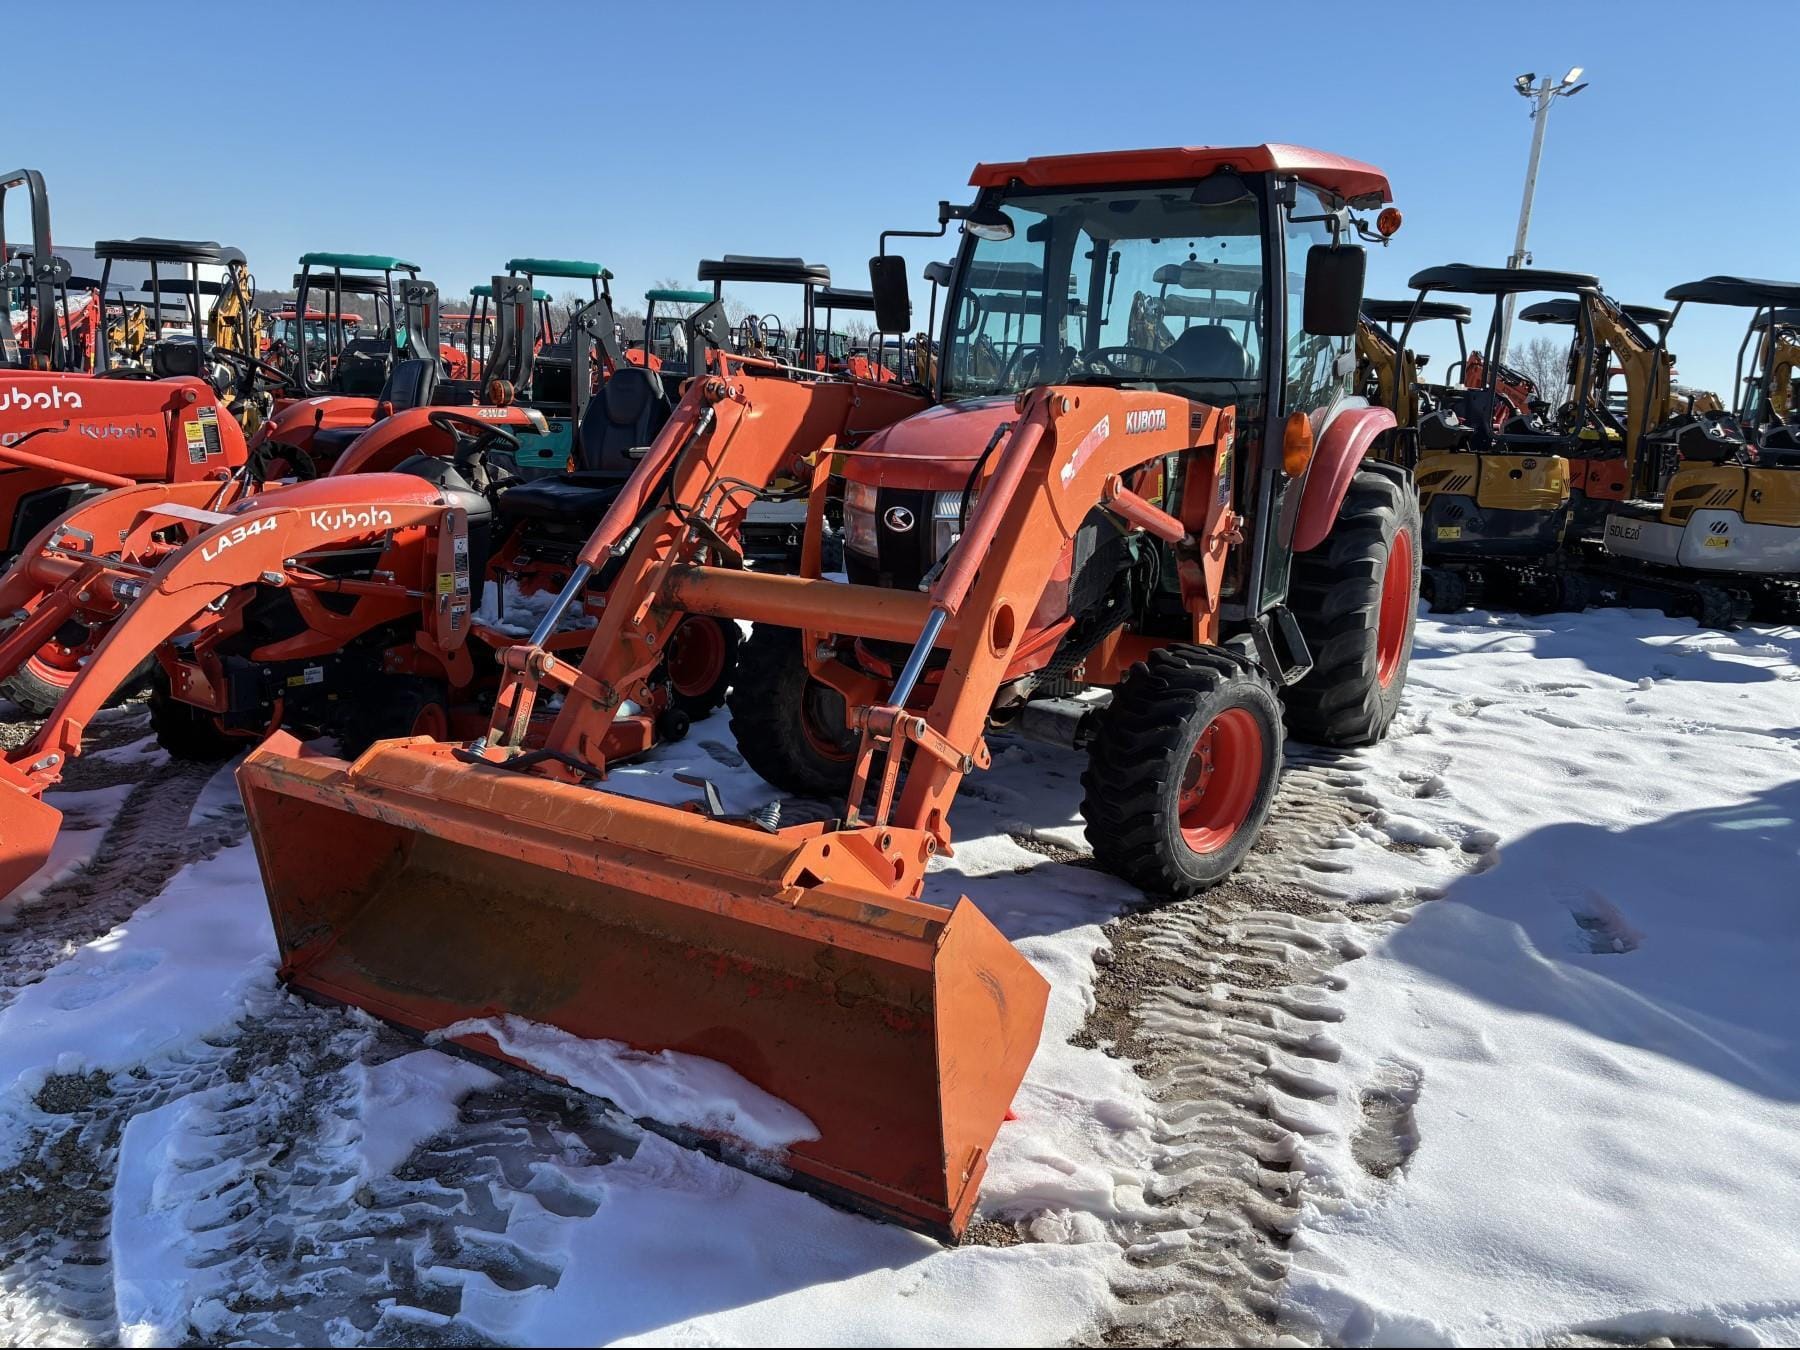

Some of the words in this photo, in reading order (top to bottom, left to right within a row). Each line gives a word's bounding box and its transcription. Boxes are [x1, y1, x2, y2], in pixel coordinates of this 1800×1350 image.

[0, 386, 82, 411] ubota
[478, 407, 508, 418] 4WD
[1125, 408, 1168, 435] KUBOTA
[79, 423, 157, 439] Kubota
[310, 505, 392, 531] Kubota
[201, 515, 278, 562] LA344
